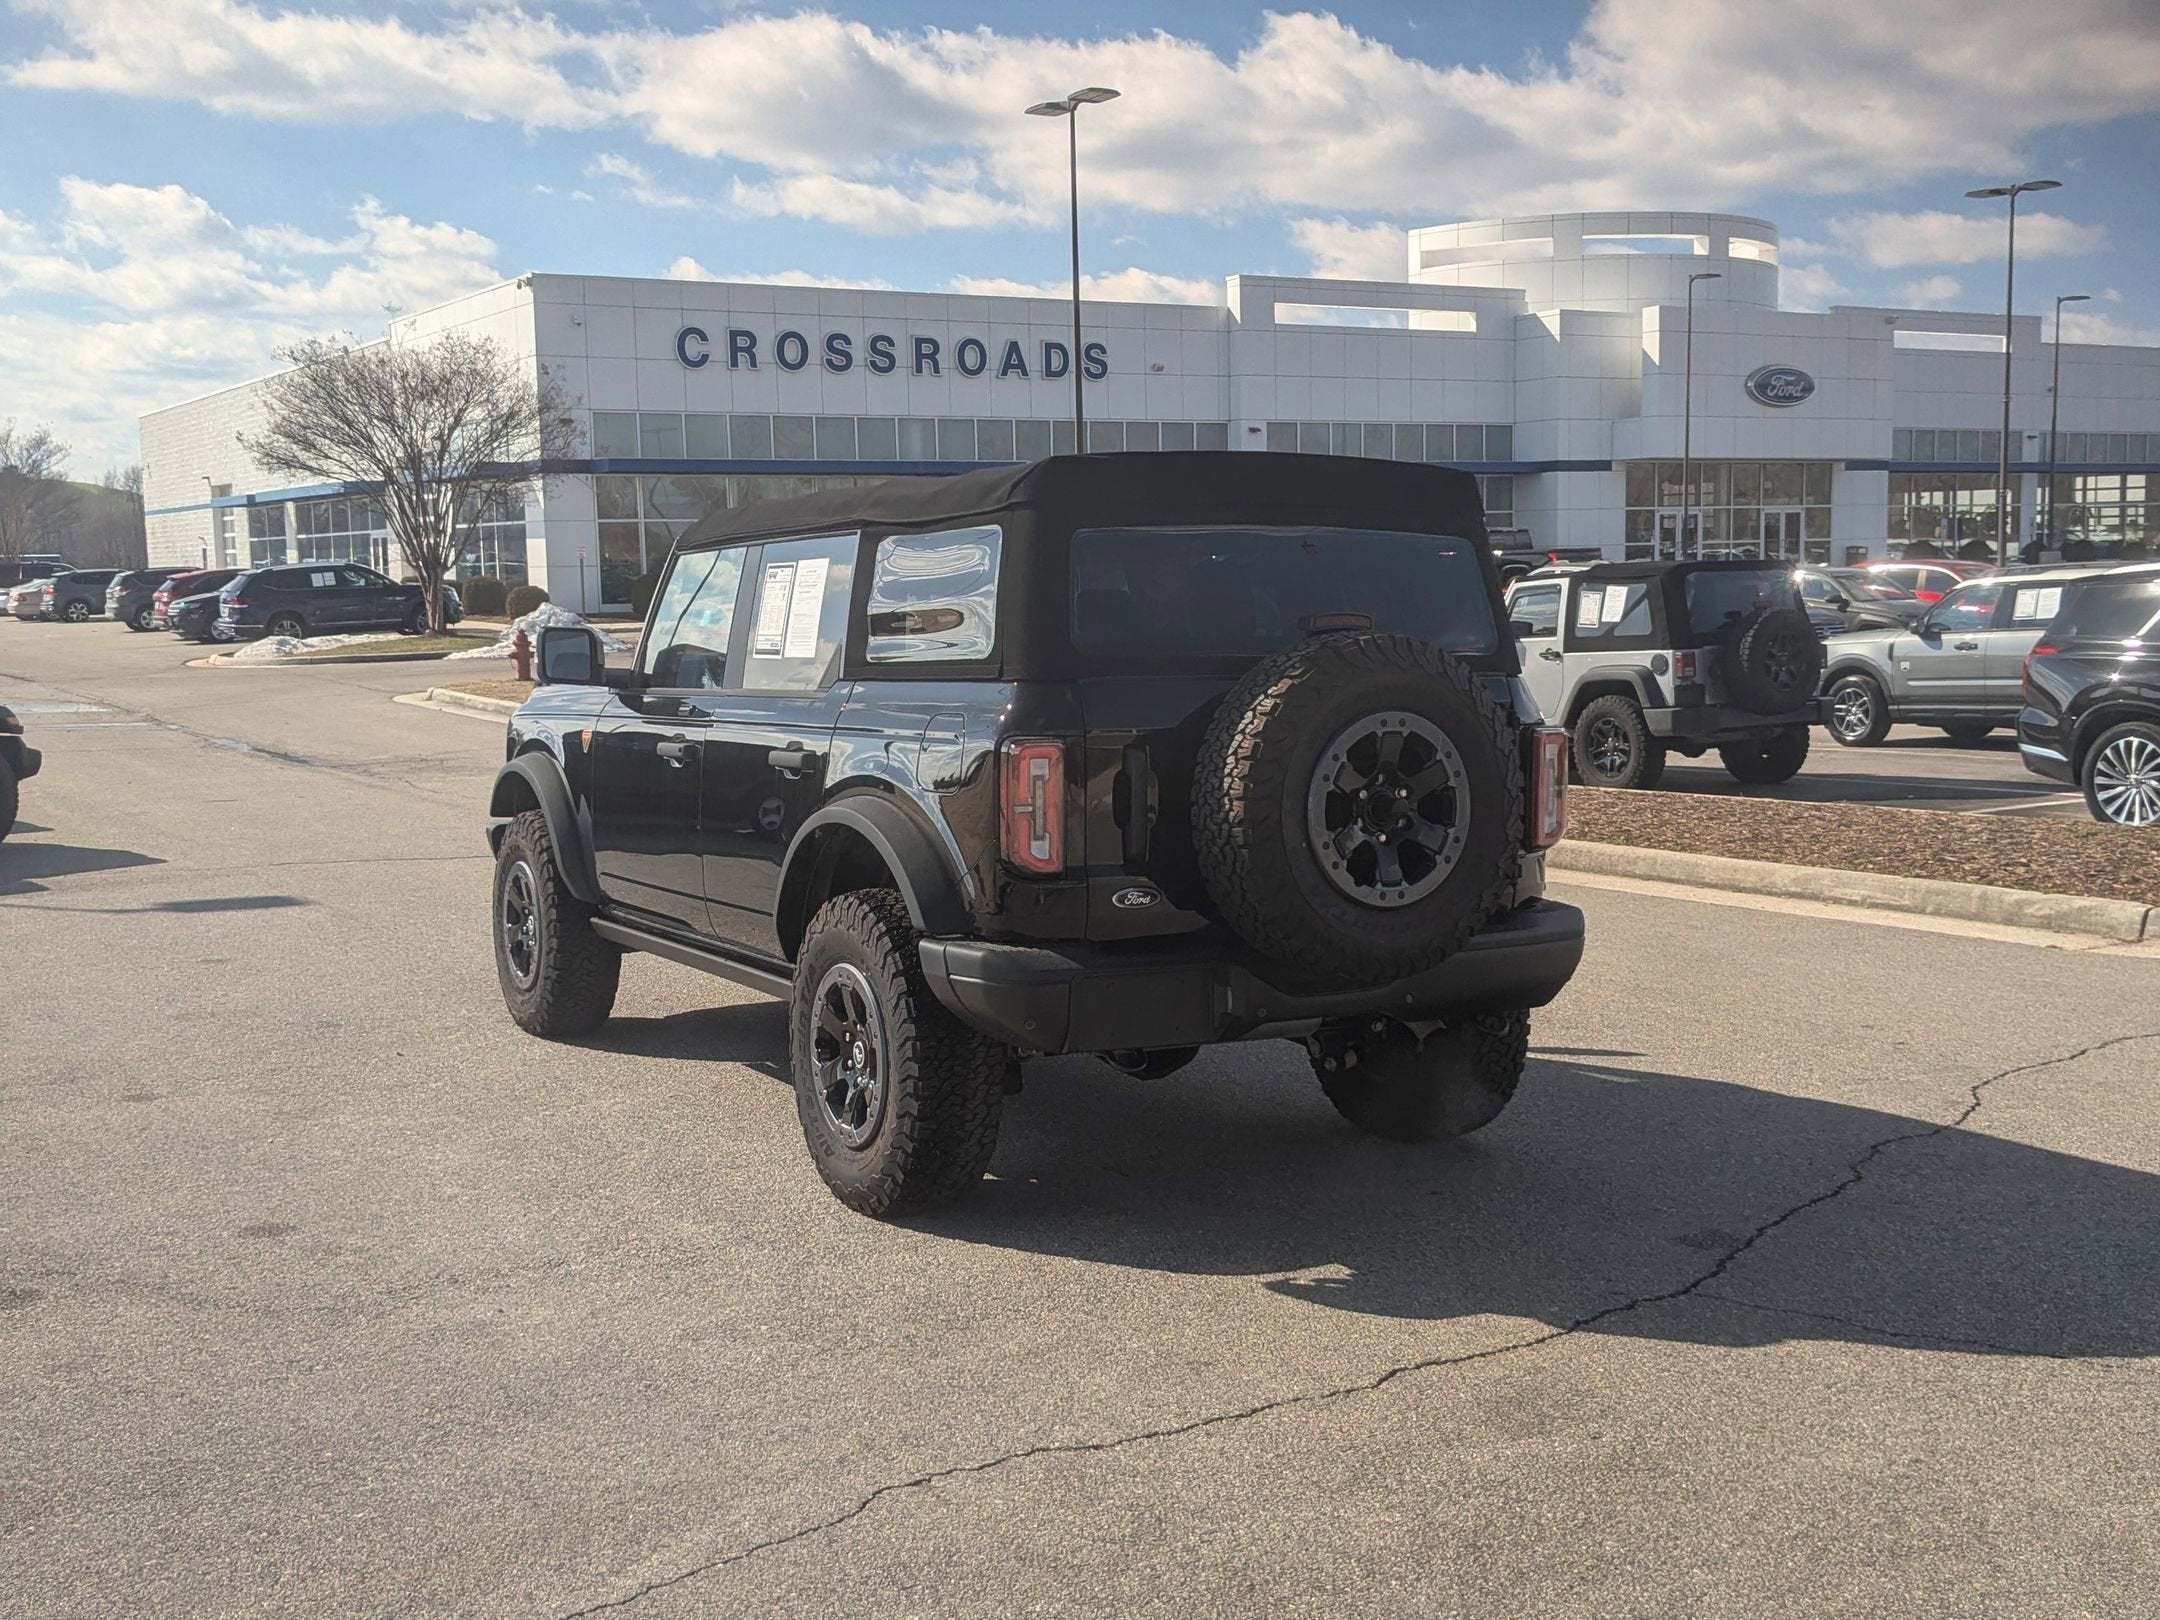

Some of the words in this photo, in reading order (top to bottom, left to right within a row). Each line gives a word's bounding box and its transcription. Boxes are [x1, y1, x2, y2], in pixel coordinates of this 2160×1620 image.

[675, 326, 1109, 381] CROSSROADS
[1767, 374, 1806, 397] Ford
[1124, 891, 1152, 905] Ford
